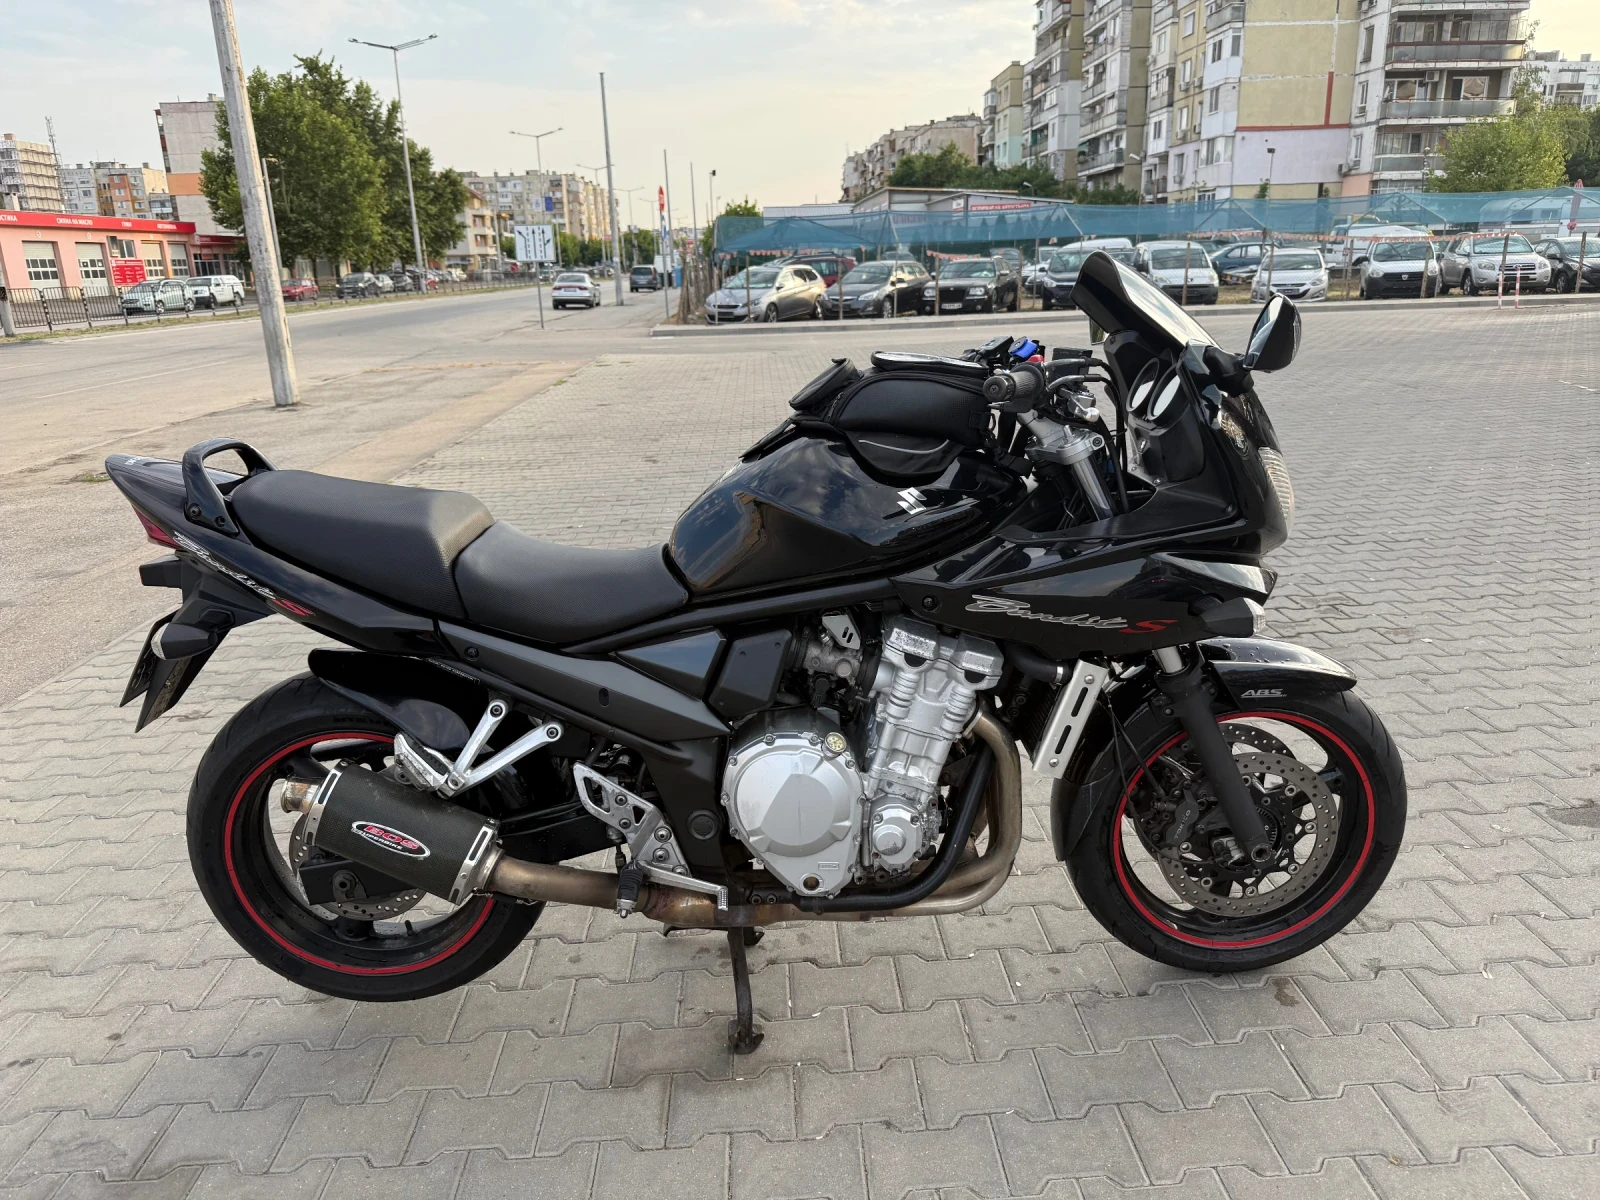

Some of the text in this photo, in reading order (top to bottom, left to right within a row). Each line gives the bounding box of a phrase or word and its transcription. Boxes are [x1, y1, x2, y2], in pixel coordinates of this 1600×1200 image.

[173, 530, 315, 616] Bandit S
[965, 594, 1179, 634] Bandit S
[1240, 688, 1283, 698] ABS
[363, 825, 420, 850] BOS
